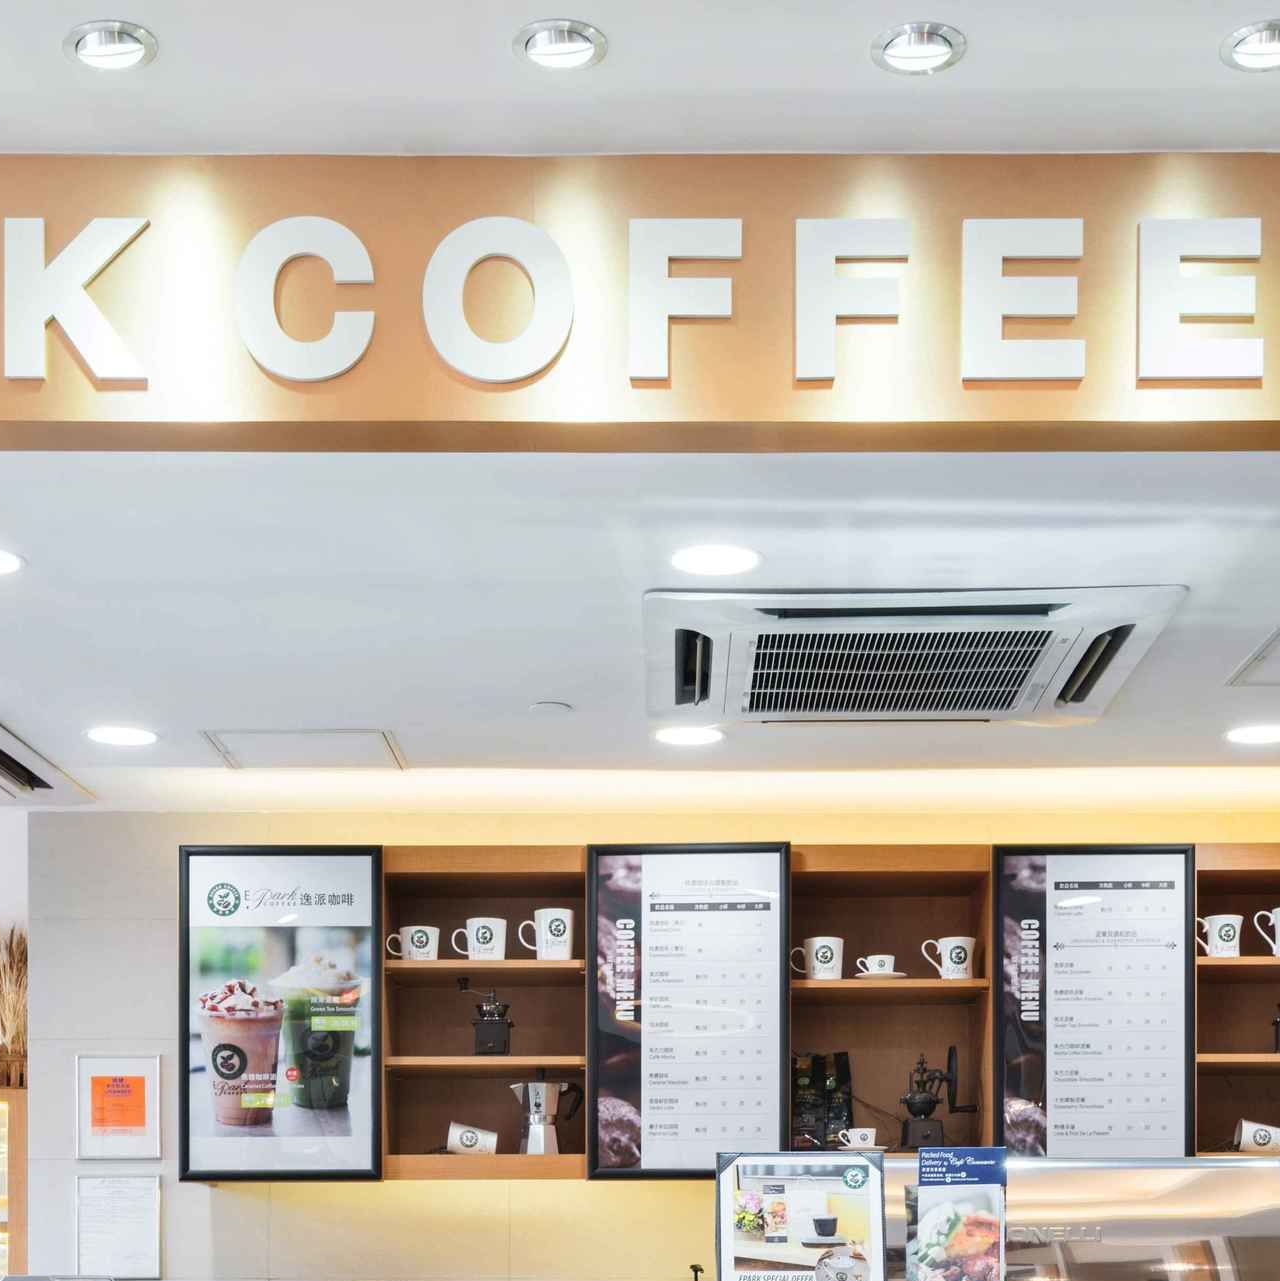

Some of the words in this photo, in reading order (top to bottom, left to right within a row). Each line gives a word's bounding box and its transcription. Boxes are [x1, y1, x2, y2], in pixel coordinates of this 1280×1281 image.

[233, 214, 1264, 384] COFFEE
[300, 893, 355, 906] 逸派咖啡
[616, 918, 635, 973] COFFEE
[1020, 918, 1040, 973] COFFEE
[616, 979, 634, 1021] MENU
[1020, 979, 1040, 1021] MENU
